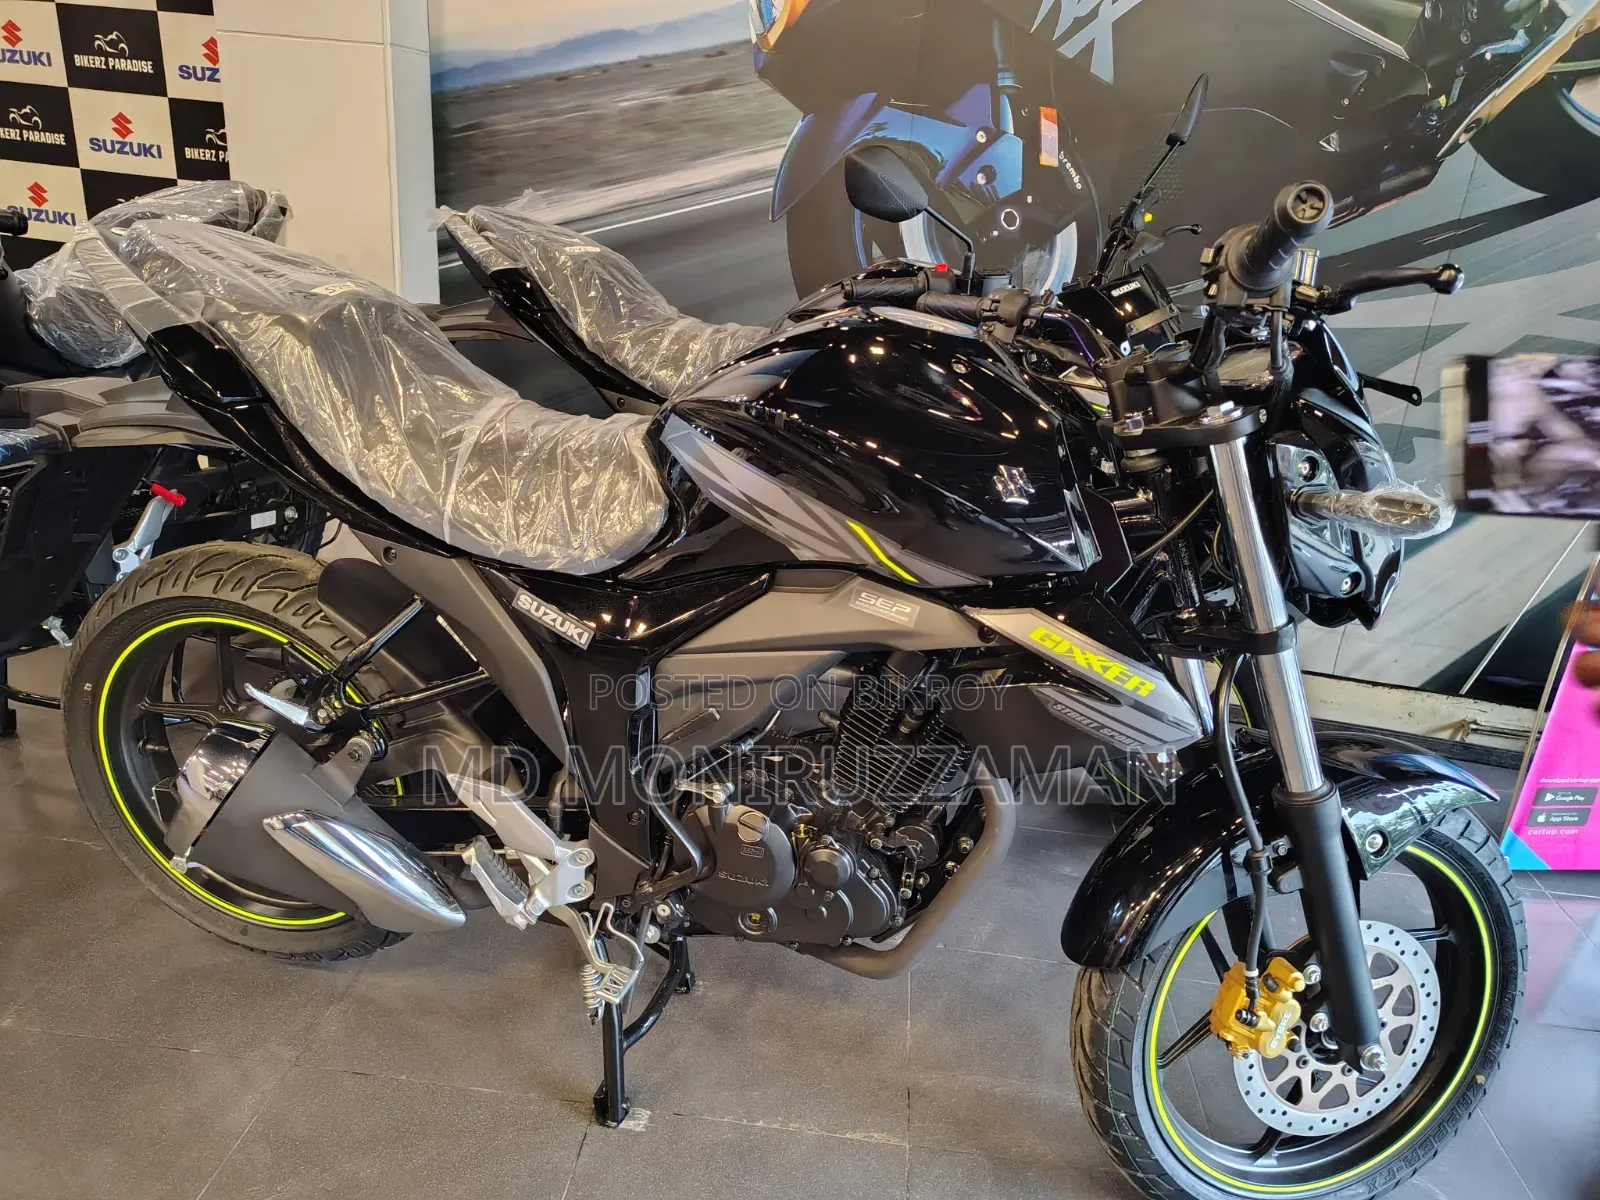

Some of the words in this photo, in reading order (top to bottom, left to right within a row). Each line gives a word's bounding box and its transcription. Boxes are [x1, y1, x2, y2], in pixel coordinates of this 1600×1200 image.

[73, 54, 107, 69] BIKERZ
[108, 57, 154, 73] PARADISE
[22, 130, 67, 145] PARADISE
[88, 137, 162, 159] SUZUKI
[184, 147, 217, 162] BIKERZ
[1058, 151, 1082, 190] brembo
[1110, 280, 1141, 297] SUZUKI
[858, 592, 912, 613] SEP
[516, 593, 589, 645] SUZUKI
[1029, 626, 1155, 697] GIXXER
[1052, 703, 1102, 728] STREET
[1100, 727, 1142, 748] SPORT
[1528, 828, 1579, 836] cartup.com
